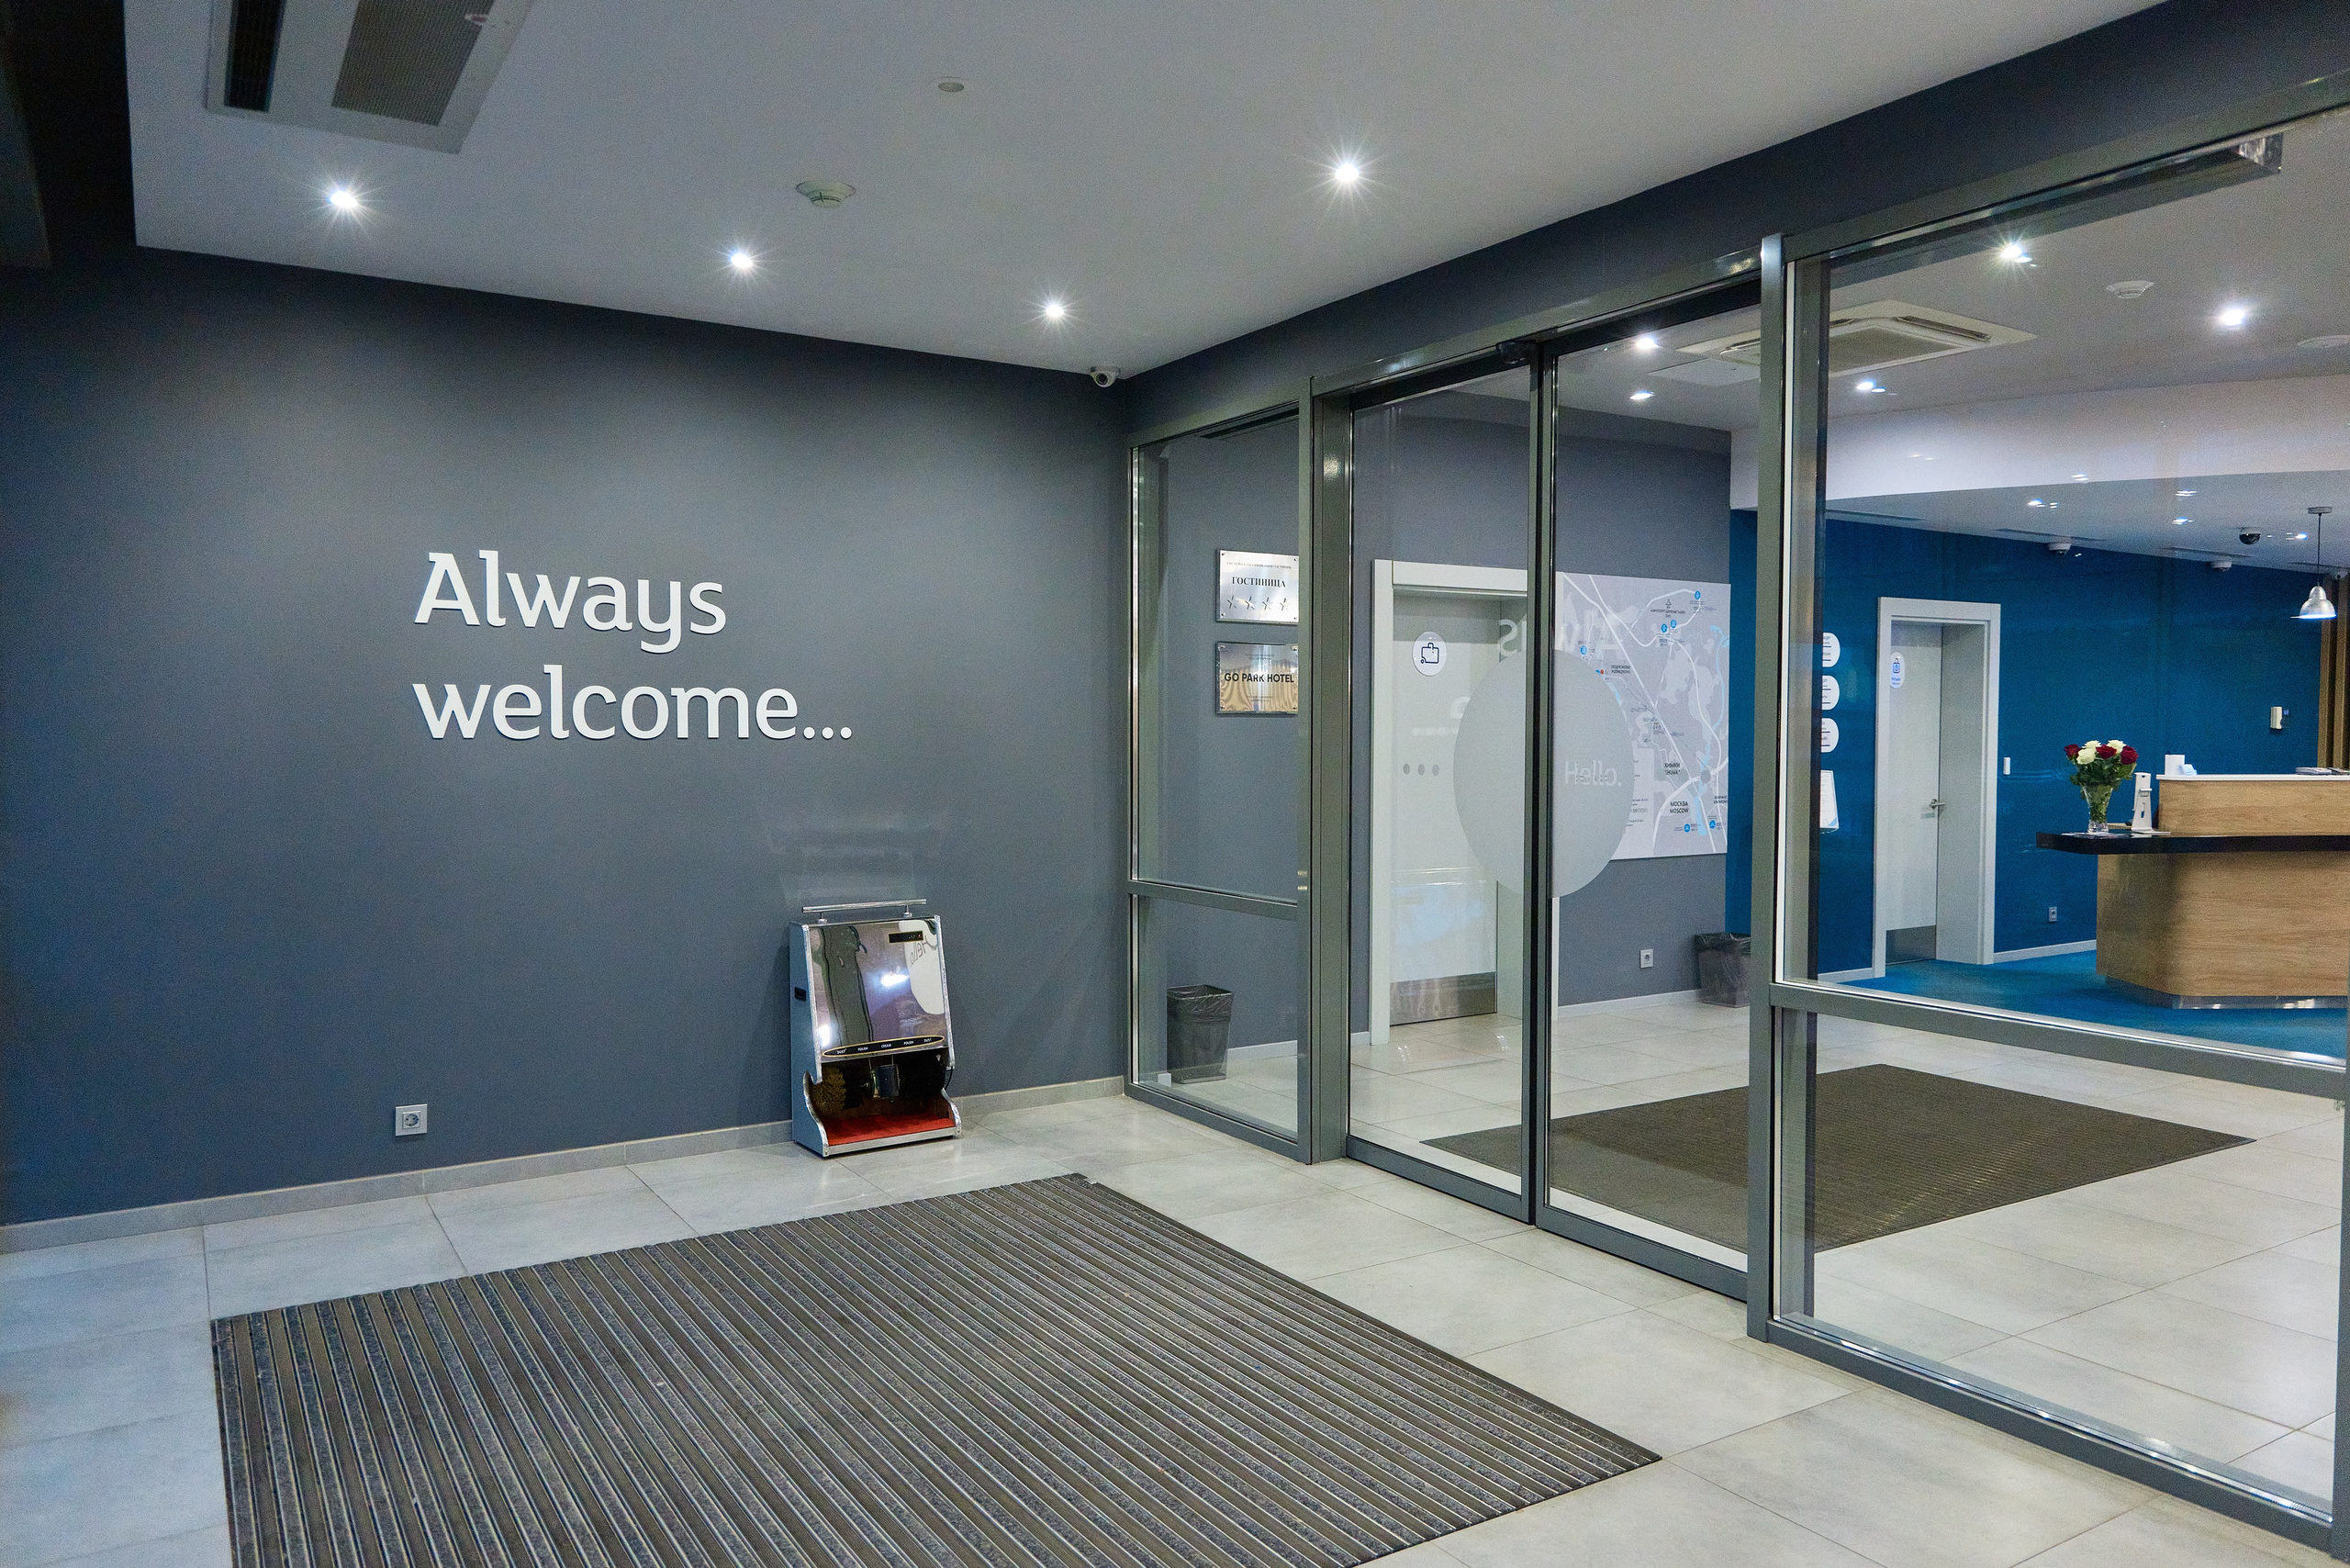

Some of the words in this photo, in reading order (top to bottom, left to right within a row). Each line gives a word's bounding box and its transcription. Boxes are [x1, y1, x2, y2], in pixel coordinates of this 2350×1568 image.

[1232, 577, 1286, 588] ГОСТИНИЦА
[413, 550, 727, 654] Always
[1224, 673, 1239, 682] GO
[1241, 673, 1265, 682] PARK
[1267, 674, 1294, 683] HOTEL
[412, 665, 853, 739] welcome...
[1564, 759, 1622, 787] Hello.
